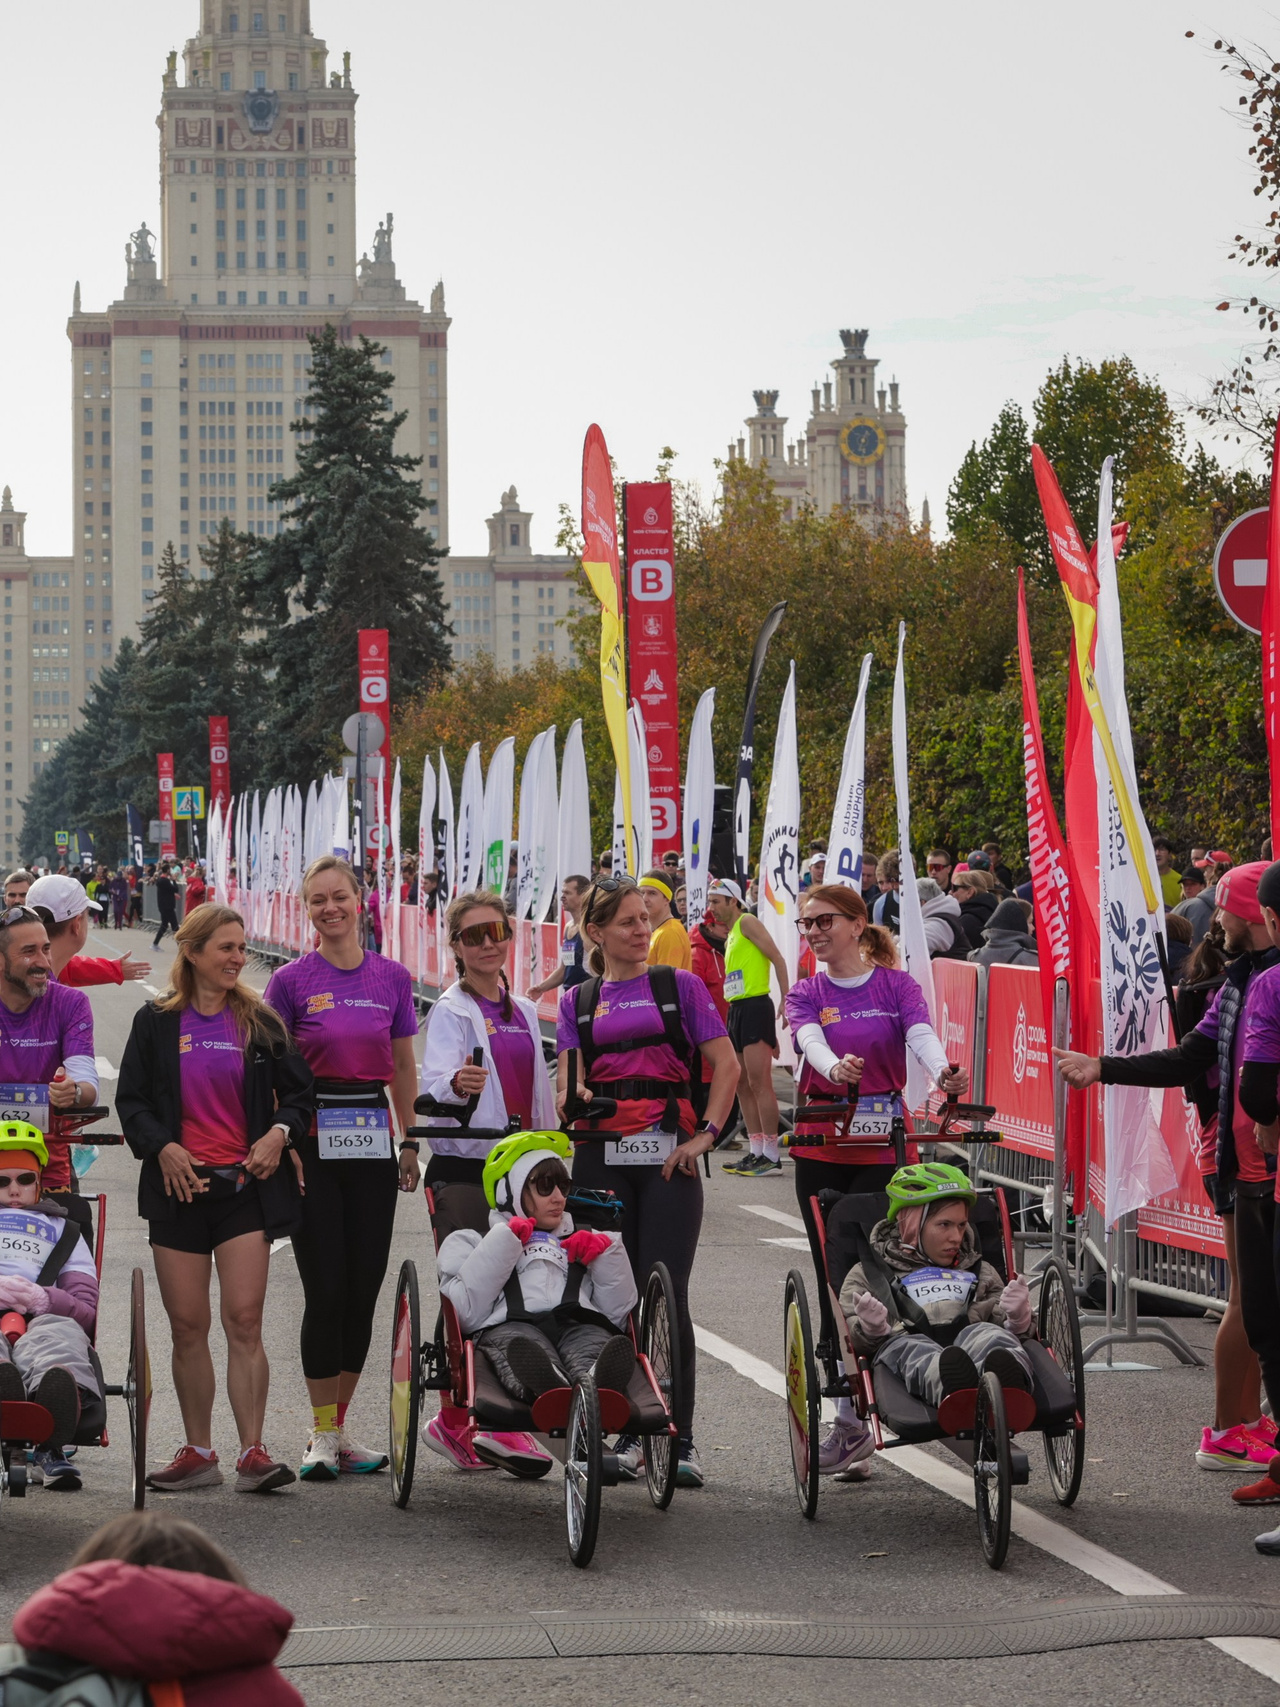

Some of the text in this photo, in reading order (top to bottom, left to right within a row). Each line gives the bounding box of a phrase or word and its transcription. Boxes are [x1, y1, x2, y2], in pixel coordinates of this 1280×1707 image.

[641, 568, 663, 594] B
[327, 1135, 373, 1147] 15639
[614, 1141, 660, 1153] 15633
[915, 1284, 963, 1298] 15648
